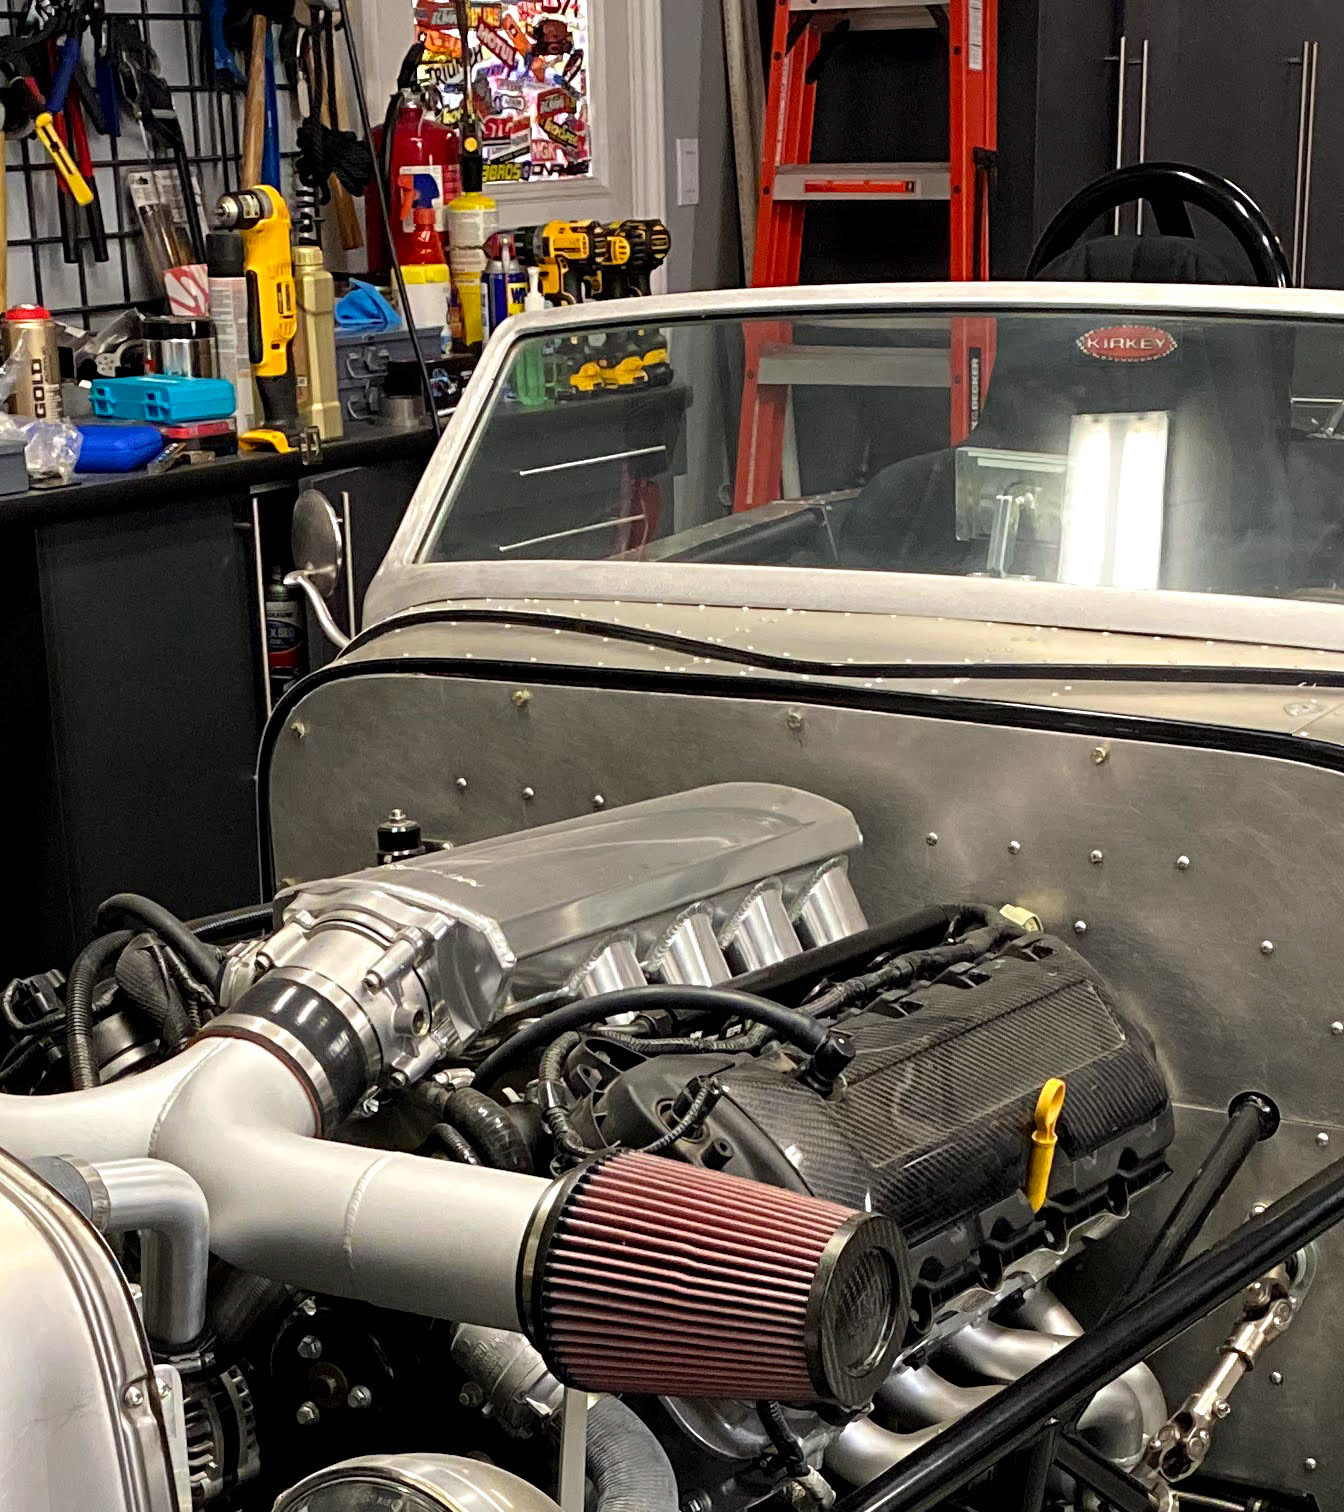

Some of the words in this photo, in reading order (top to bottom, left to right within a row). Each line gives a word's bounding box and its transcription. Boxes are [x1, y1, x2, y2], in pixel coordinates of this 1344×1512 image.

[477, 23, 516, 67] MOTUL
[532, 141, 556, 161] NGK
[1087, 337, 1166, 350] KIRKEY
[32, 358, 46, 418] GOLD
